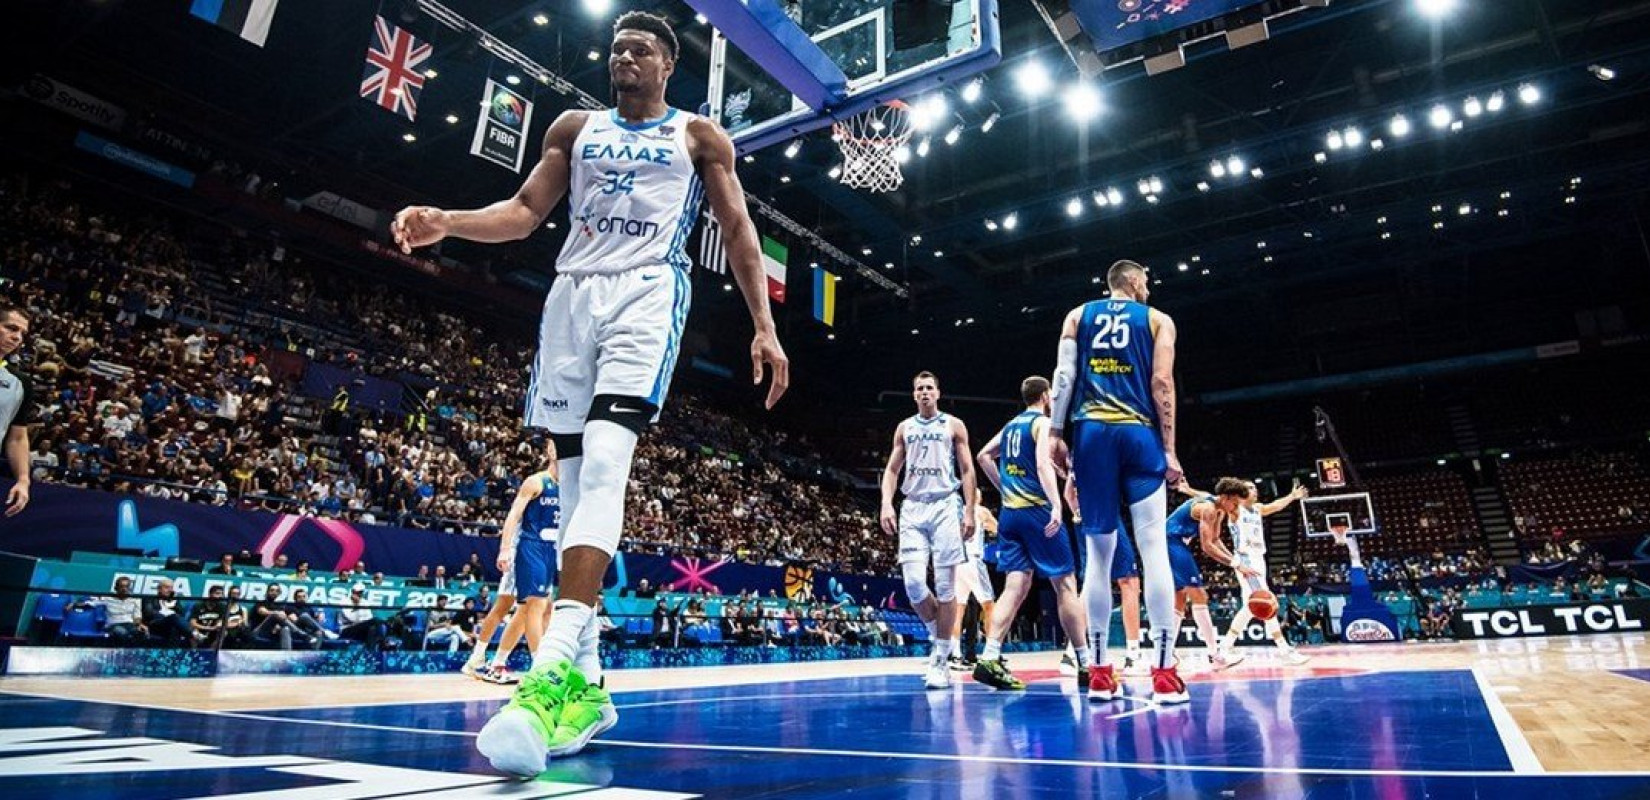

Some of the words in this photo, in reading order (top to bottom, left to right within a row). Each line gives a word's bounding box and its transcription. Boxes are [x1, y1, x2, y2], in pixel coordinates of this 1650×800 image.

[56, 91, 115, 122] Spotify
[489, 126, 515, 148] FIBA
[601, 170, 636, 195] 34
[1092, 314, 1131, 349] 25
[921, 446, 928, 459] 7
[1006, 428, 1021, 458] 10
[1462, 611, 1545, 636] TCL
[1553, 604, 1642, 632] TCL
